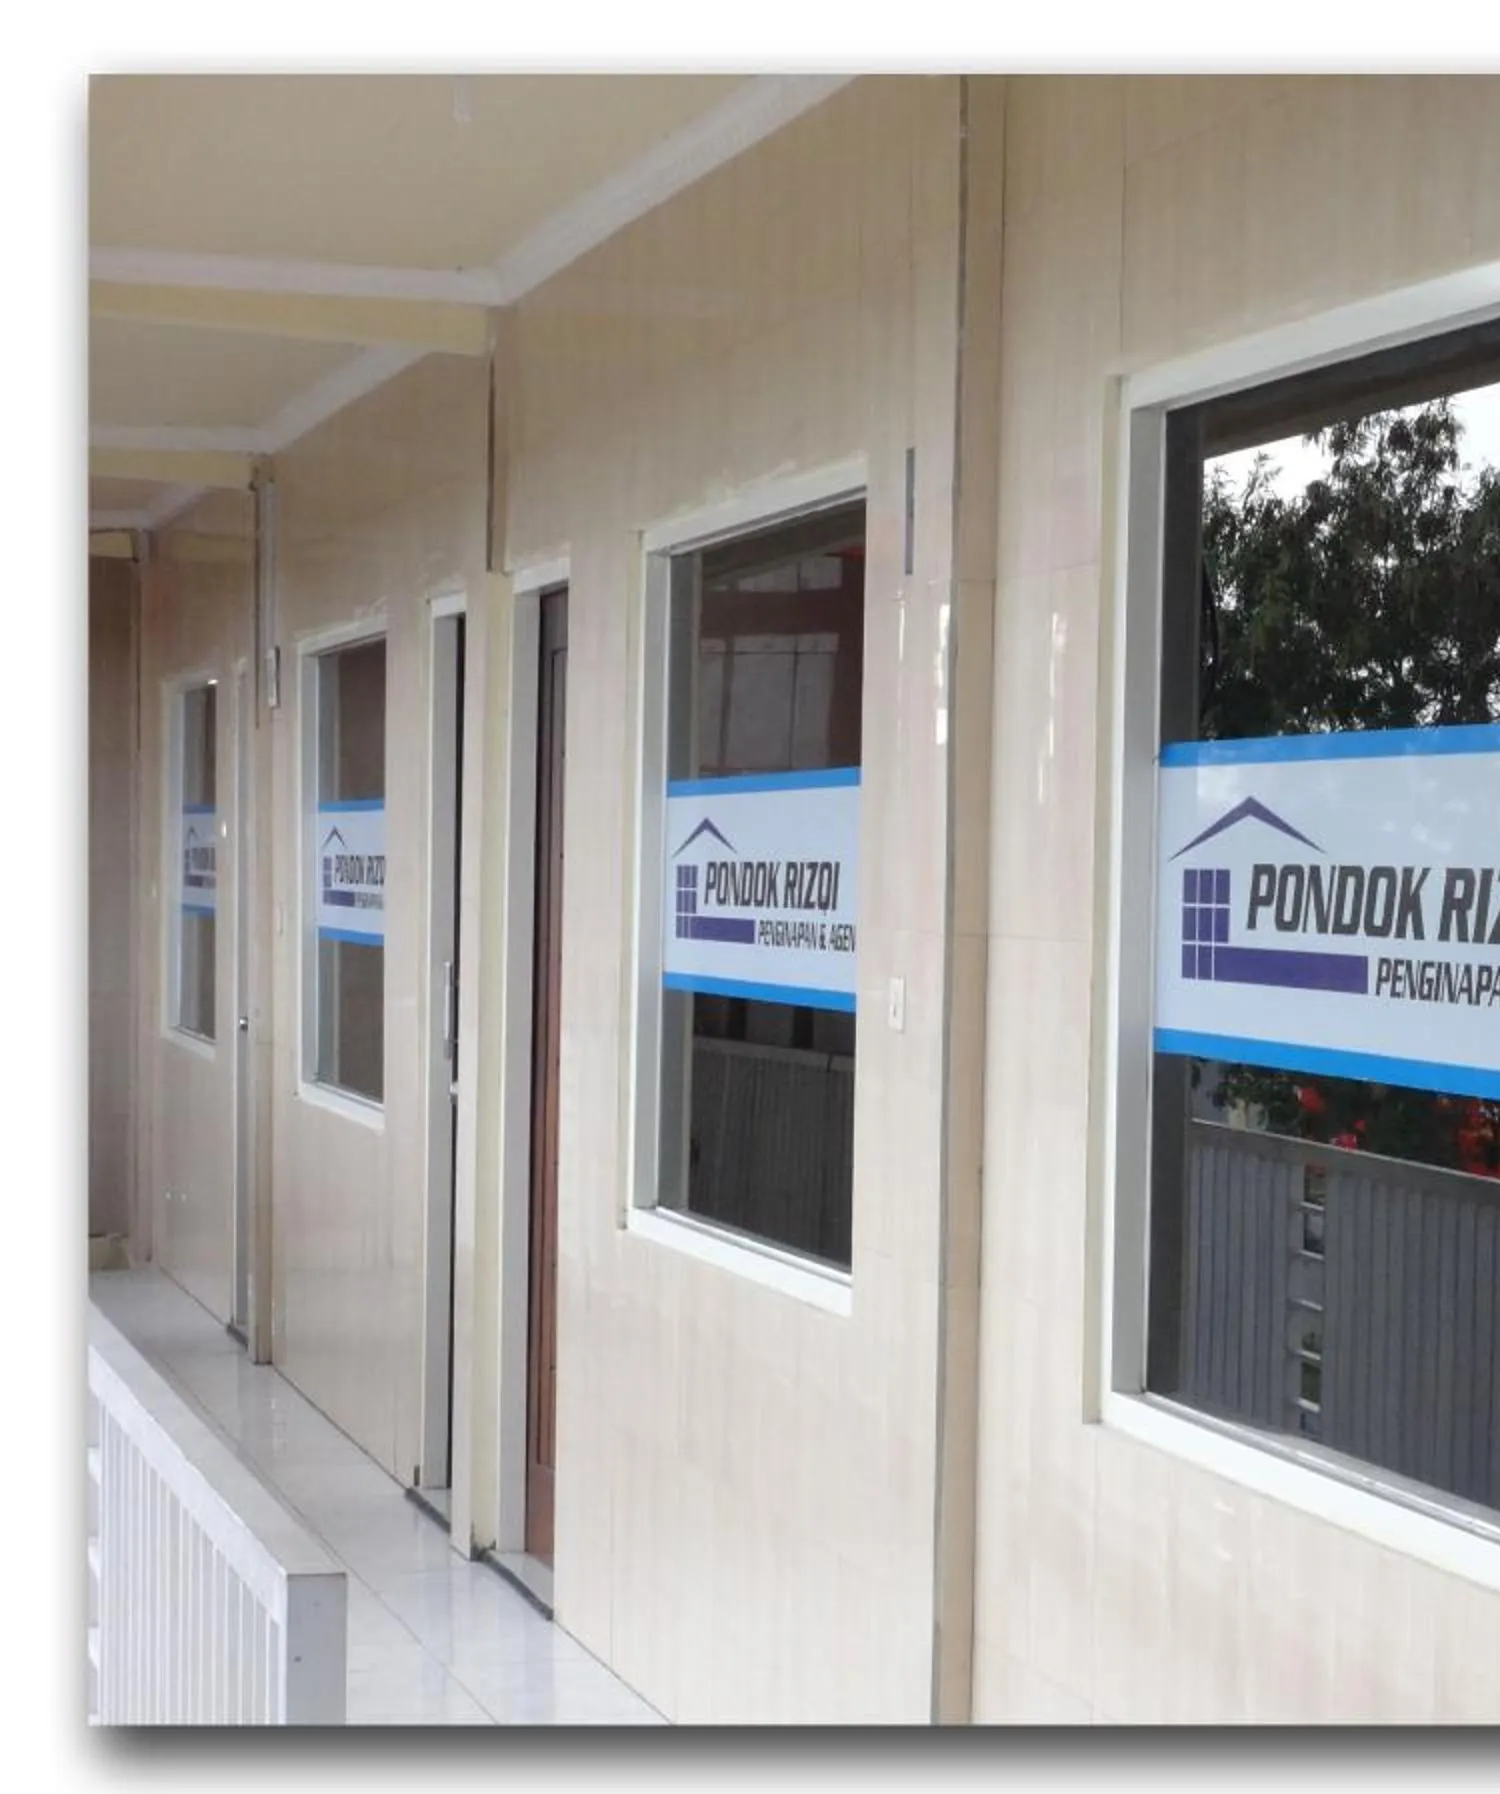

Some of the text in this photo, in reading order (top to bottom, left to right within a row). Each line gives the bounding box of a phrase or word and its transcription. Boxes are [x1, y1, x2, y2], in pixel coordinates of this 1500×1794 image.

[704, 861, 841, 917] PONDOK RIZQI
[1246, 863, 1430, 943] PONDOK
[828, 923, 856, 952] AGEN
